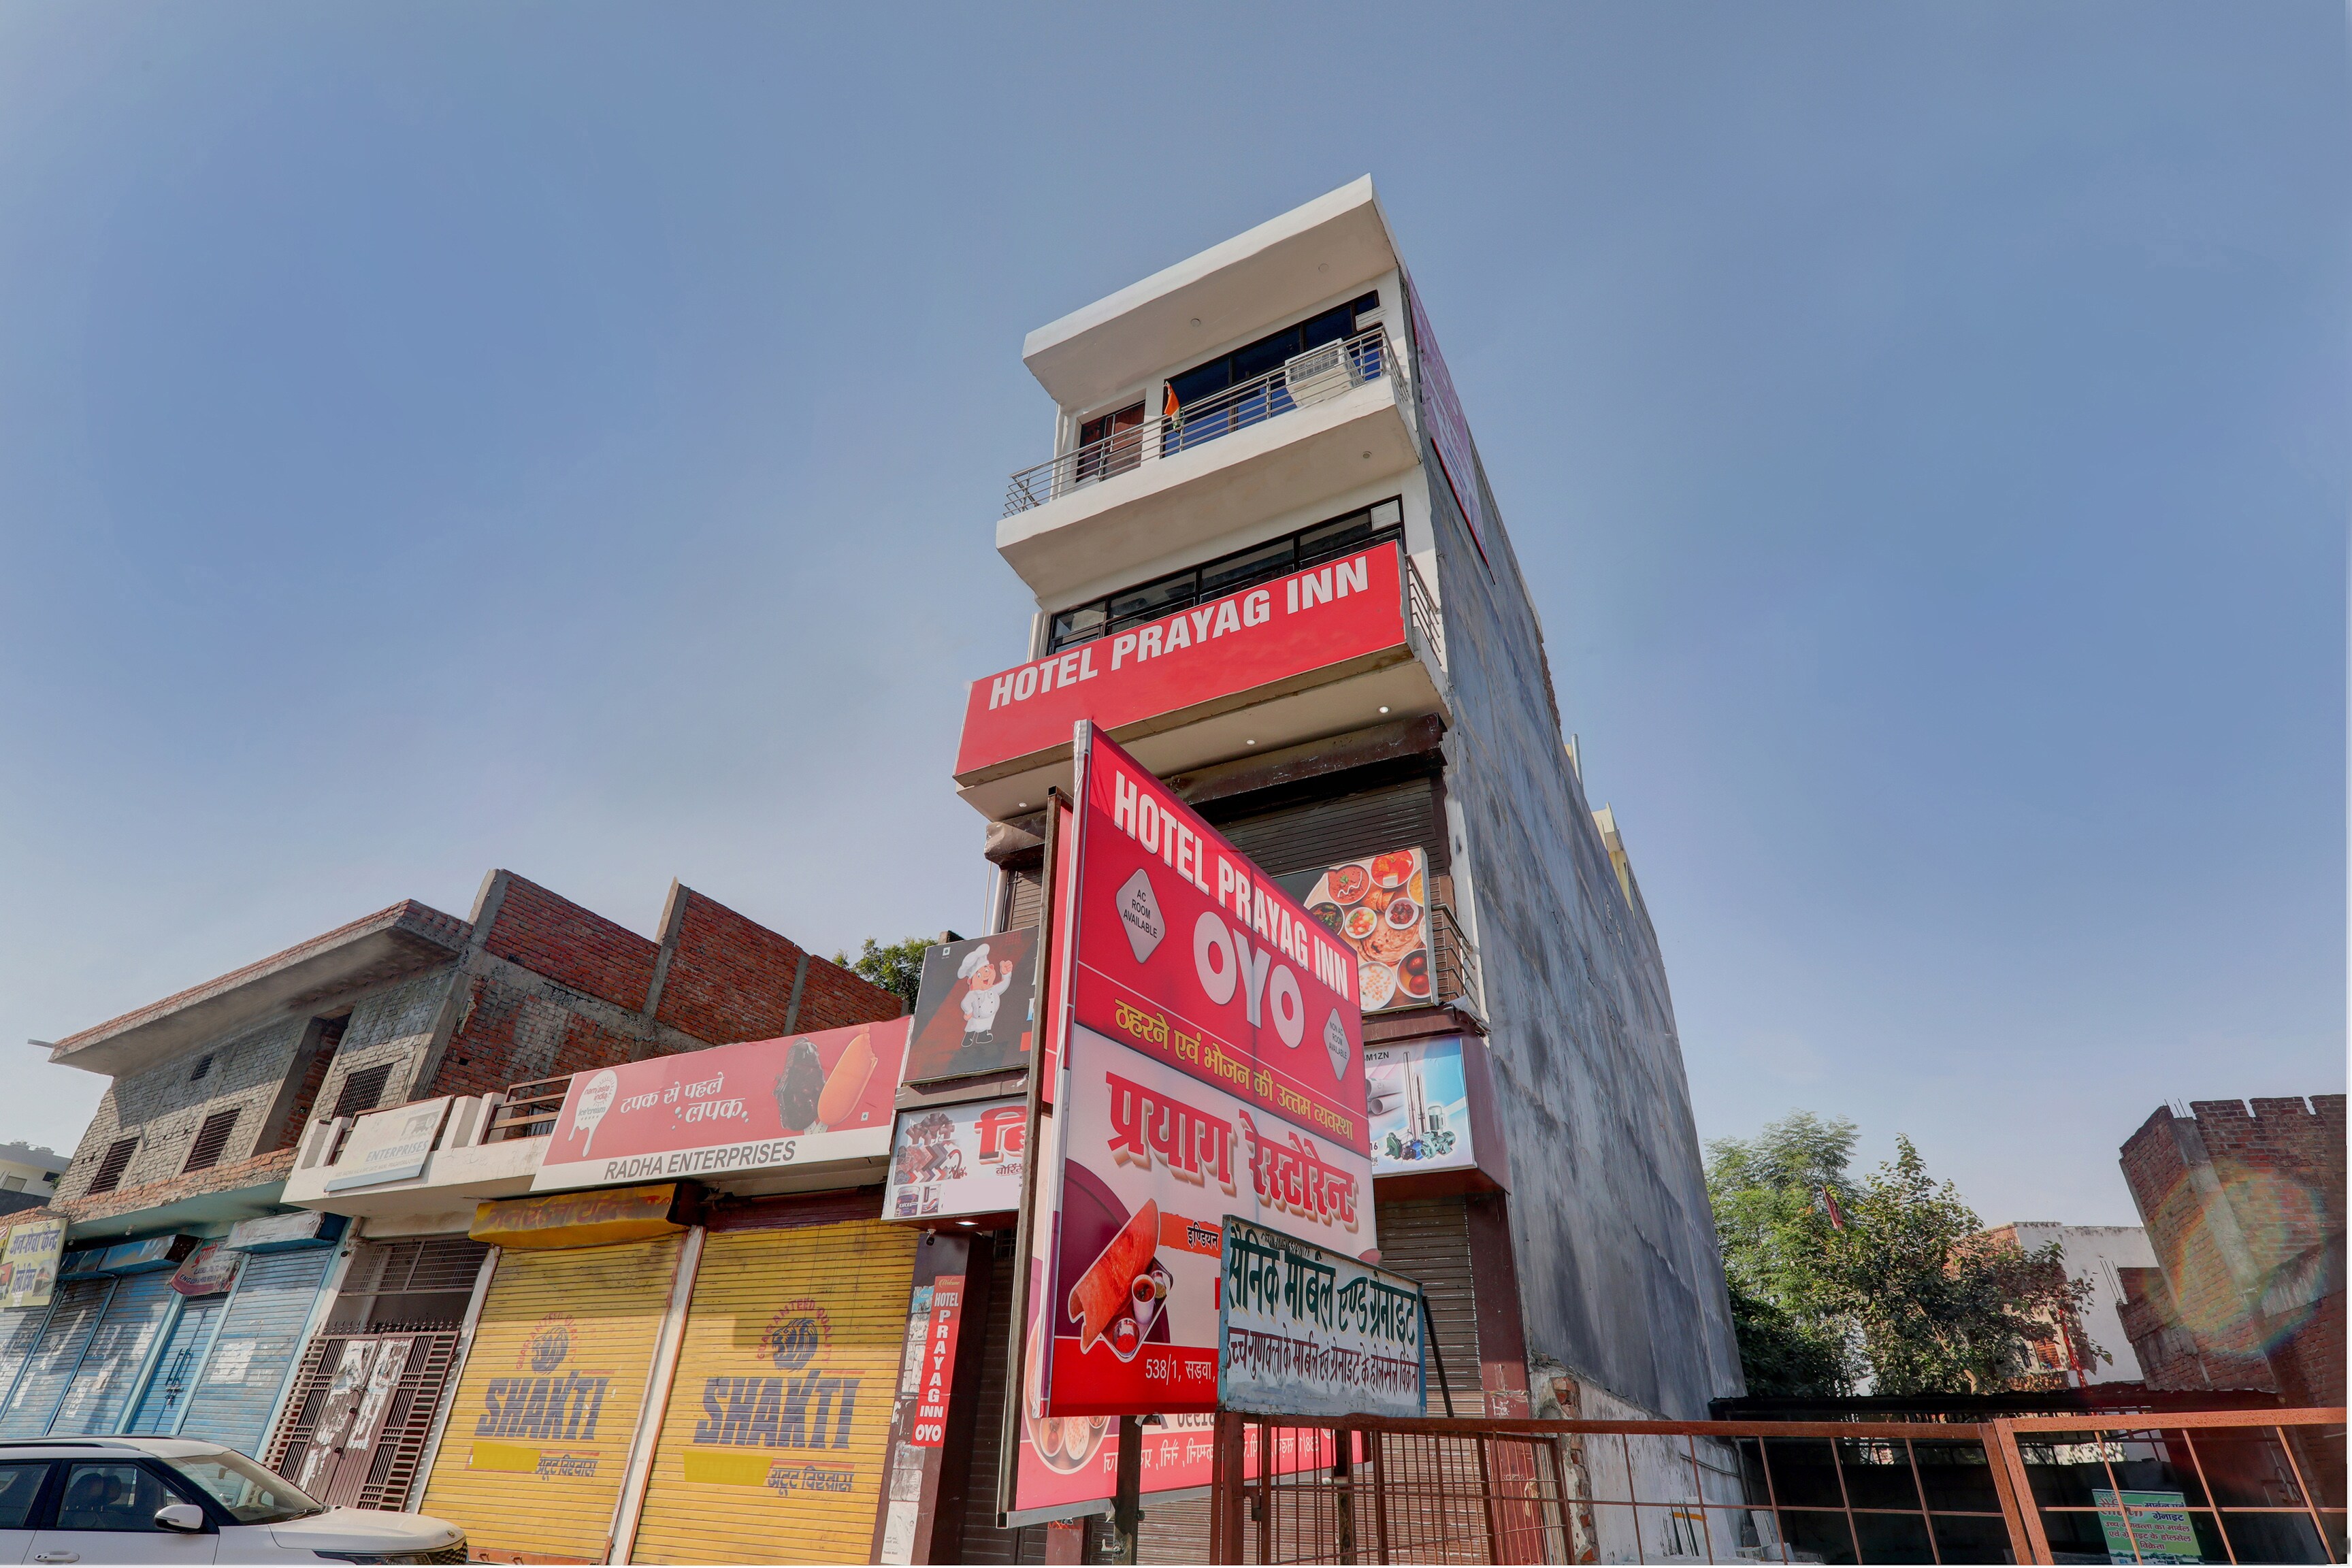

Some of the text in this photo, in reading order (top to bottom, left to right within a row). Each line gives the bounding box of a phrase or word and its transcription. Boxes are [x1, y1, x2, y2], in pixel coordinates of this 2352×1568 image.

[989, 556, 1369, 710] HOTEL PRAYAG INN
[1114, 770, 1350, 1001] HOTEL PRAYAG INN
[1137, 889, 1147, 902] AC
[1123, 909, 1158, 938] AVAILABLE
[1131, 898, 1151, 919] ROOM
[1193, 911, 1305, 1049] OYO
[1328, 1042, 1348, 1060] AVAILABLE
[1332, 1034, 1343, 1046] ROOM
[1115, 998, 1354, 1142] ठहरने एवं भोजन की उत्तम व्यवस्था
[1364, 1051, 1389, 1062] M1ZN
[620, 1071, 725, 1113] टपक से पहले
[1106, 1071, 1234, 1190] प्रयाग
[365, 1140, 429, 1162] ENTERPRISES
[604, 1140, 796, 1180] RADHA ENTERPRISES
[1187, 1222, 1219, 1250] इण्डियन
[934, 1292, 959, 1307] HOTEL
[1229, 1223, 1417, 1348] सैनिक मार्बल एण्ड ग्रेनाइट
[756, 1298, 832, 1364] GUARANTEED QUALITY
[928, 1309, 951, 1403] PRAYAG
[1145, 1354, 1181, 1386] 538/1,
[1283, 1322, 1291, 1377] के
[1359, 1342, 1370, 1388] के
[474, 1370, 610, 1441] SHAKTI
[693, 1370, 862, 1450] SHAKTI
[919, 1405, 943, 1418] INN
[915, 1424, 942, 1442] OYO
[768, 1469, 801, 1497] अटूट
[2152, 1511, 2185, 1522] ग्रेनाइट
